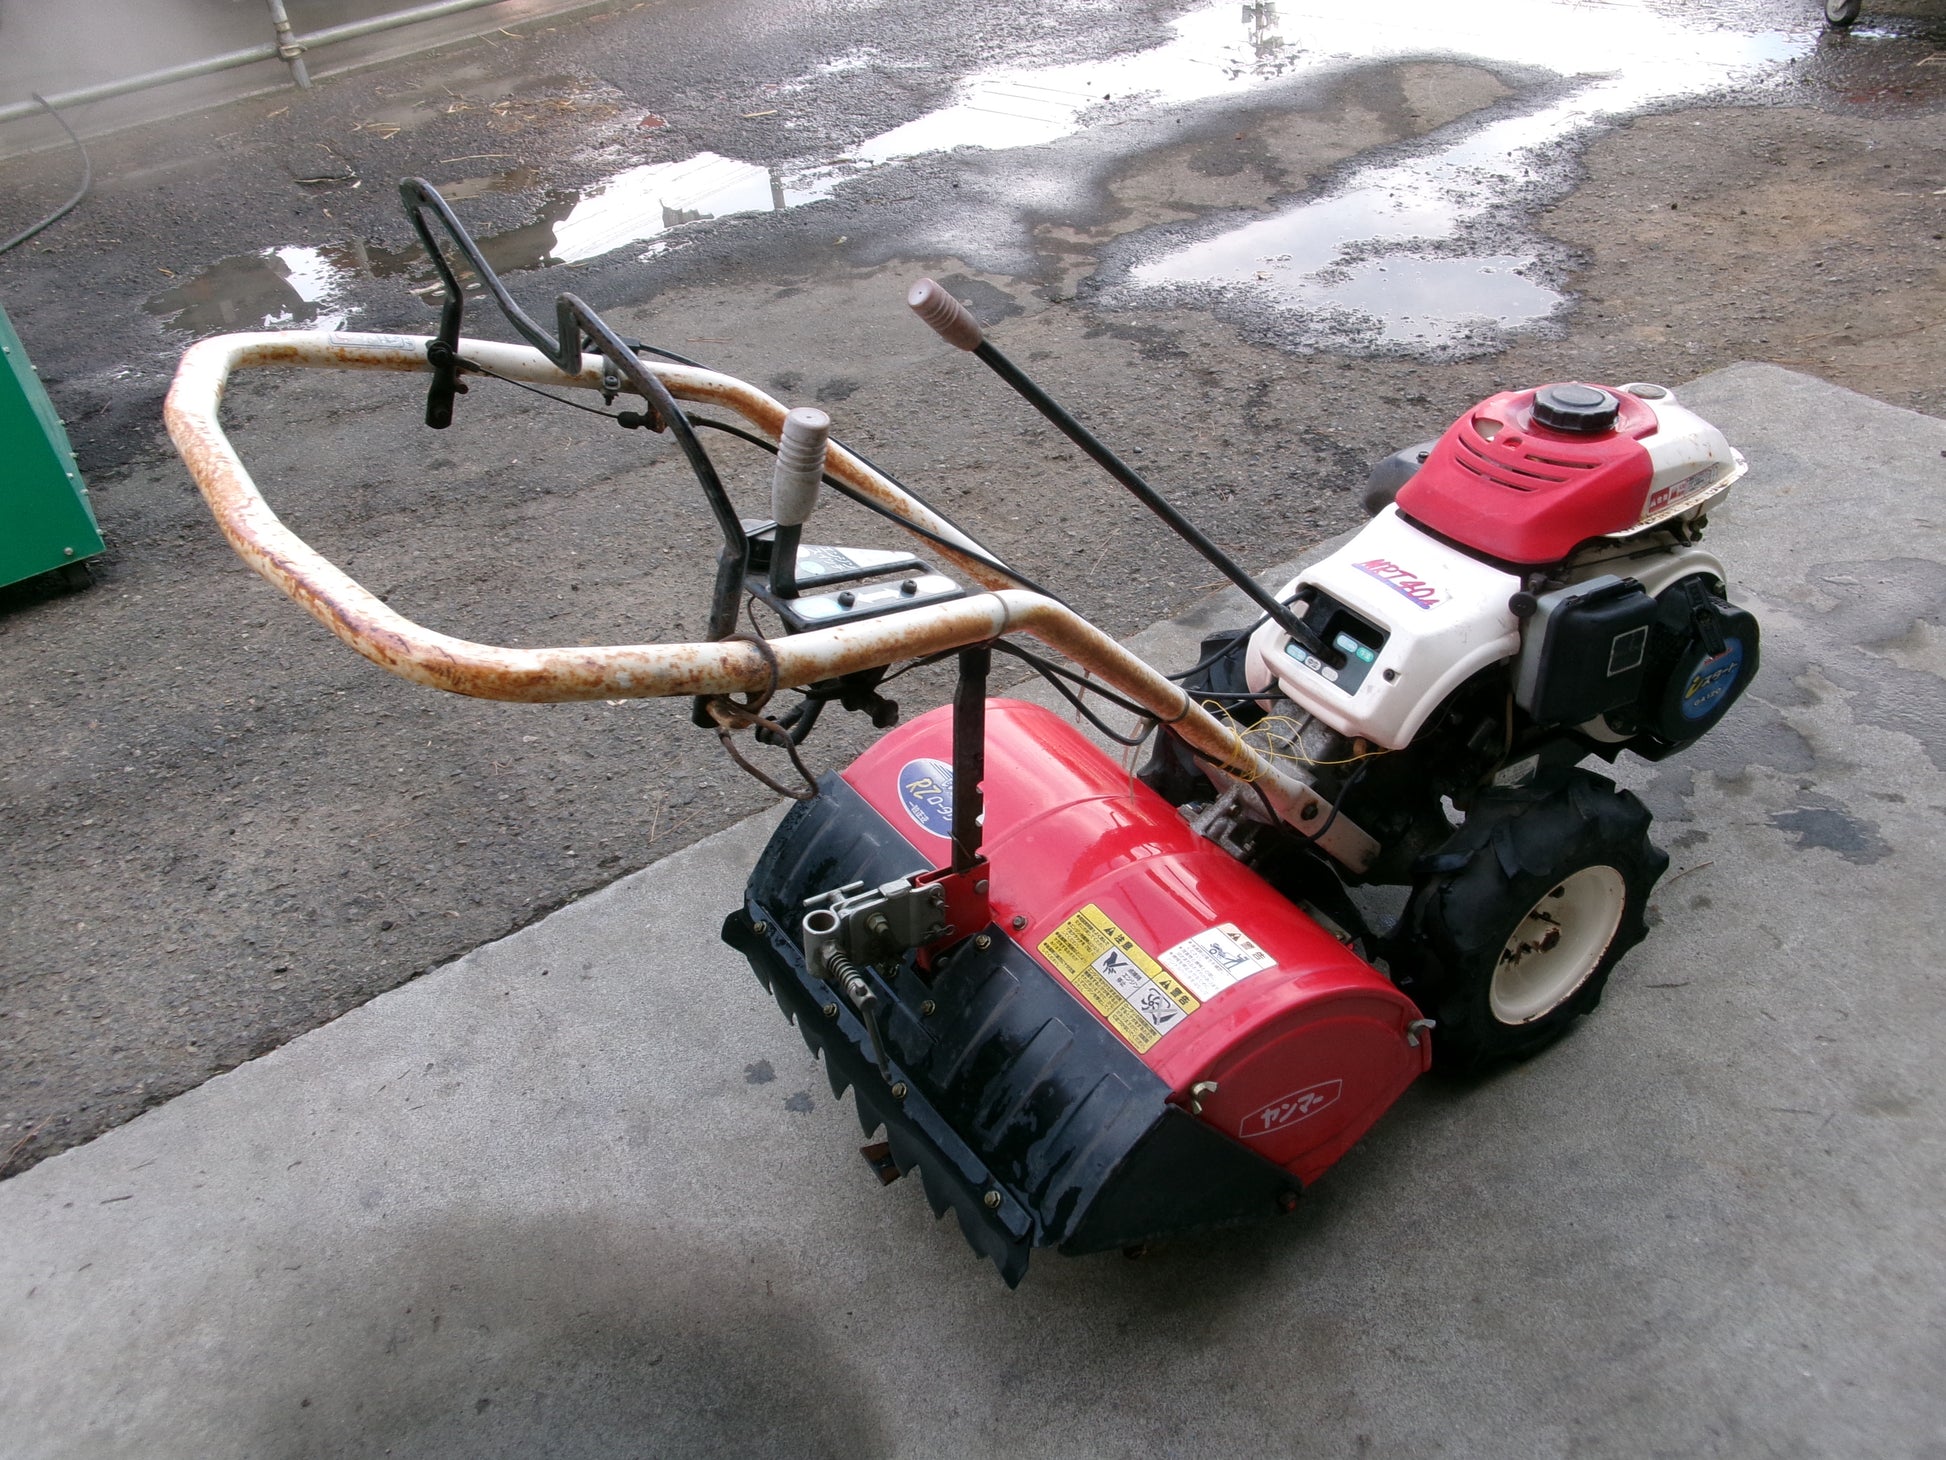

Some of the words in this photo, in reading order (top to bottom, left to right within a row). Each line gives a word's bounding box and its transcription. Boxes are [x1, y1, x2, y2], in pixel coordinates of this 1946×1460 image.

[905, 777, 943, 800] RZ
[1113, 933, 1134, 952] 注意
[1260, 1092, 1325, 1130] ヤンマー
